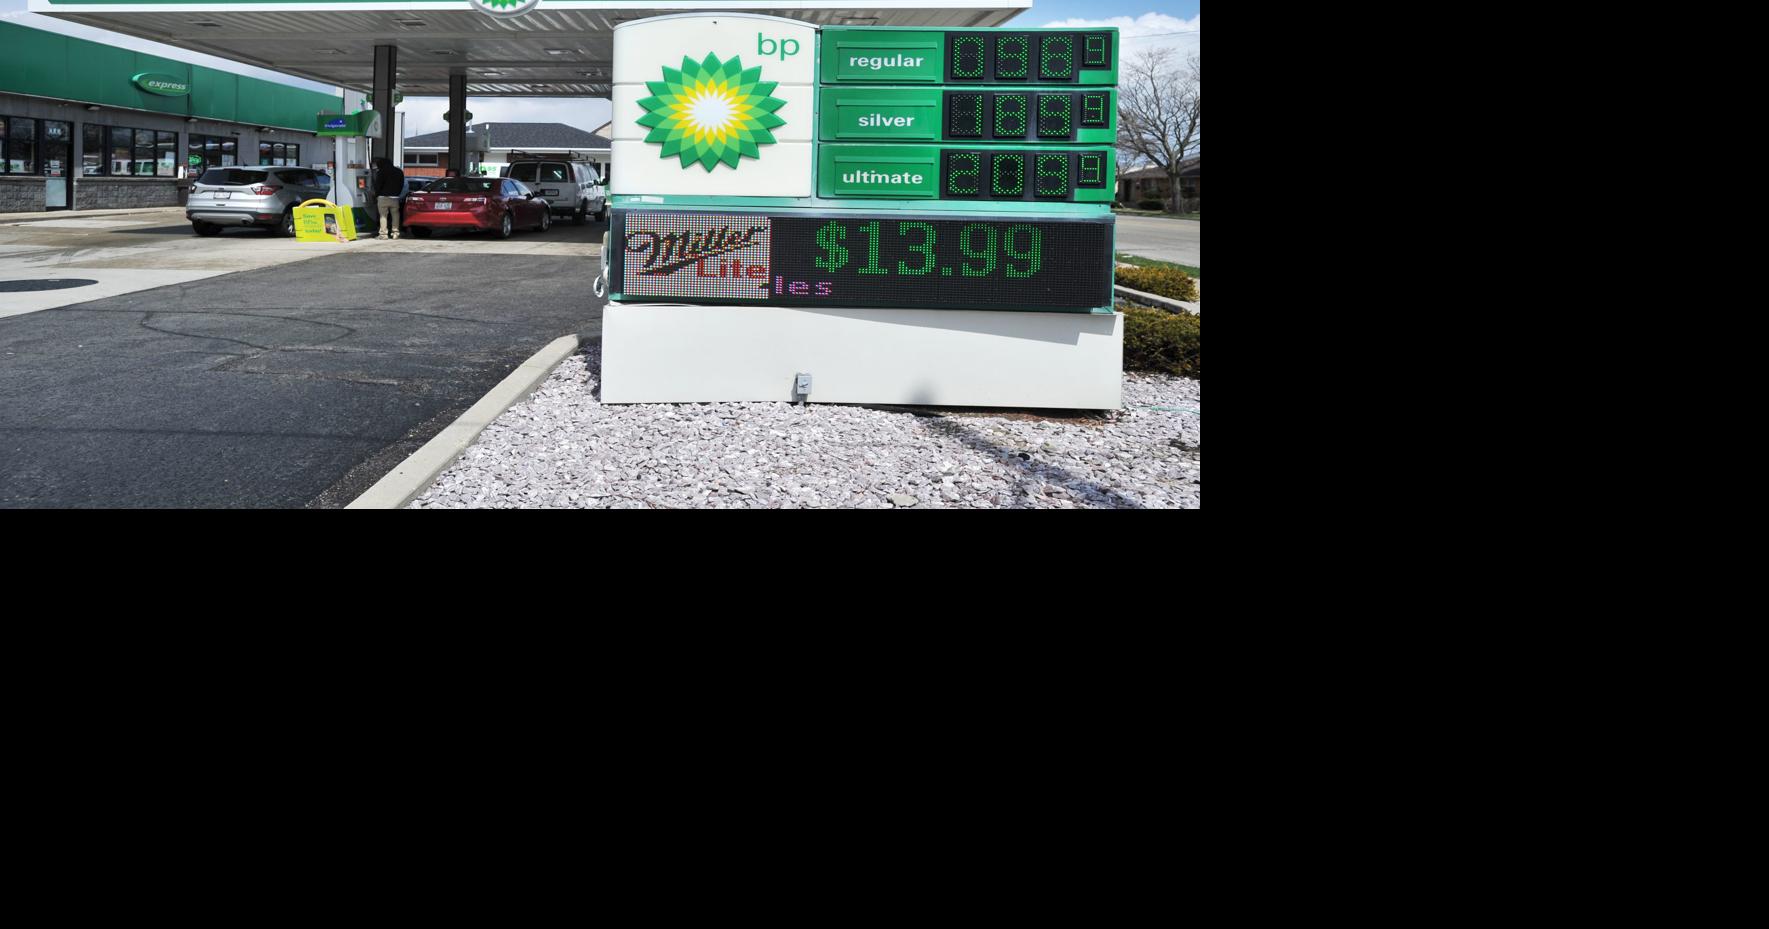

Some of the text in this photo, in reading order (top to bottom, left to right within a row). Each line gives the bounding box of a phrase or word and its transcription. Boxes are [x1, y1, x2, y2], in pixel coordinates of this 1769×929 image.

[757, 32, 800, 61] bp
[850, 54, 924, 70] regular
[148, 80, 187, 90] express
[858, 114, 915, 127] silver
[842, 170, 923, 184] ultimate
[625, 226, 769, 276] Miller
[815, 220, 1042, 278] $13.99
[697, 258, 767, 279] Lite
[775, 275, 832, 295] les
